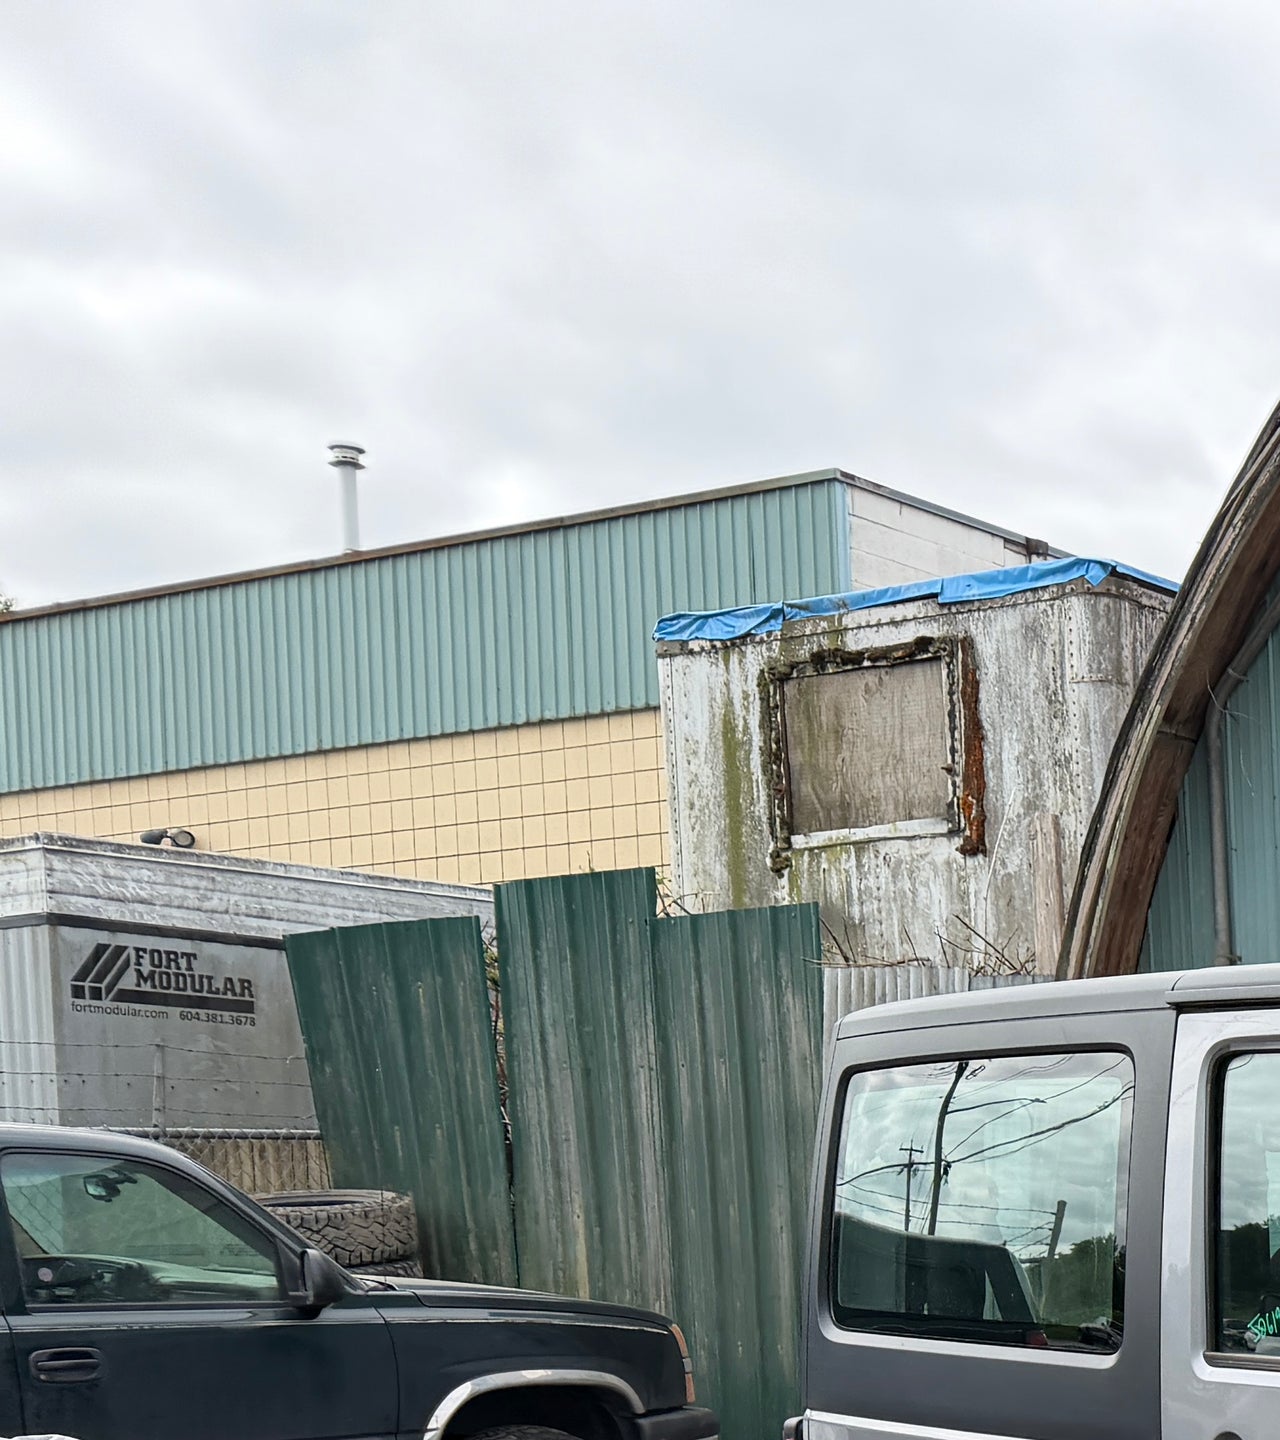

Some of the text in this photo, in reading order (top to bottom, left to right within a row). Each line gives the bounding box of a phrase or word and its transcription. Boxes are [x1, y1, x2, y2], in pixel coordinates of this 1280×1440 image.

[132, 946, 198, 972] FORT
[133, 967, 256, 999] MODULAR
[70, 1002, 257, 1028] fortmodular.com 604.381.3678
